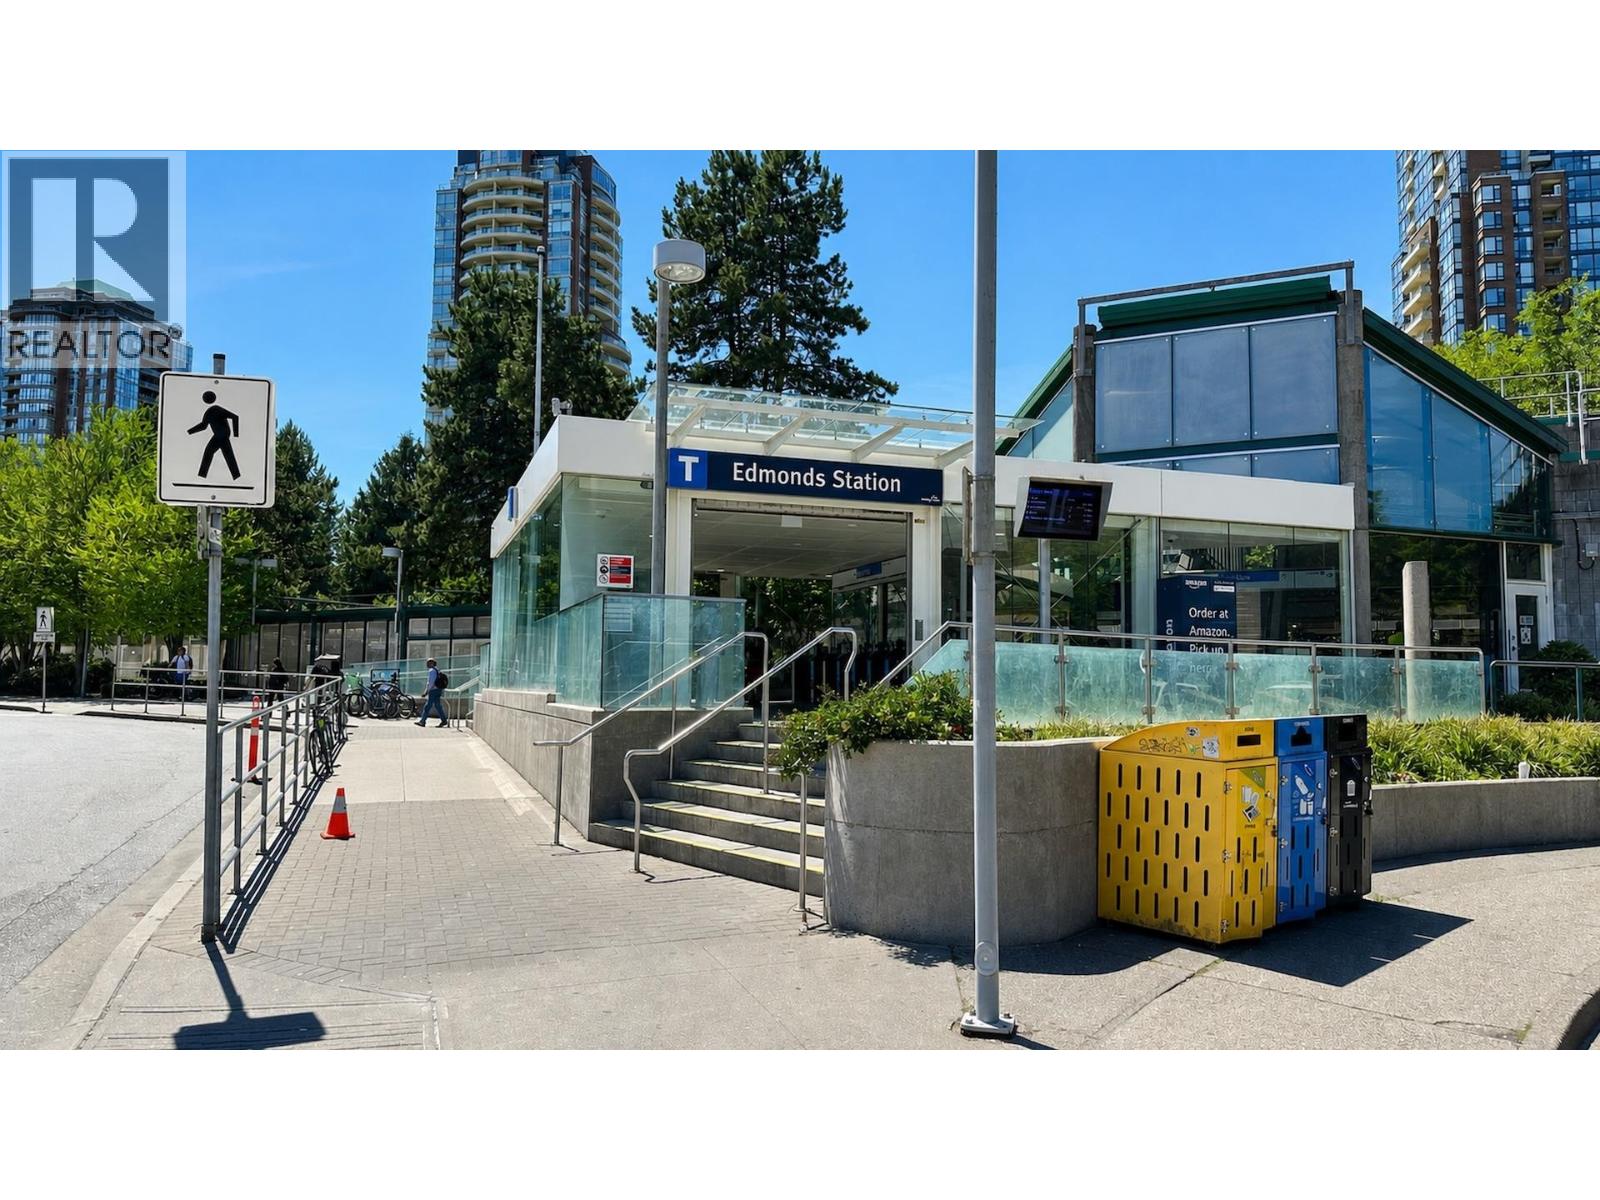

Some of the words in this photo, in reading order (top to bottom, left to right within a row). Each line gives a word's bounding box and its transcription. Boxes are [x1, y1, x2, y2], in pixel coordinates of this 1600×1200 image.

[678, 455, 699, 481] T
[733, 462, 826, 487] Edmonds
[832, 470, 901, 493] Station
[1189, 607, 1217, 619] Order
[1219, 610, 1229, 619] at
[1189, 626, 1231, 637] Amazon.
[1189, 643, 1209, 654] Pick
